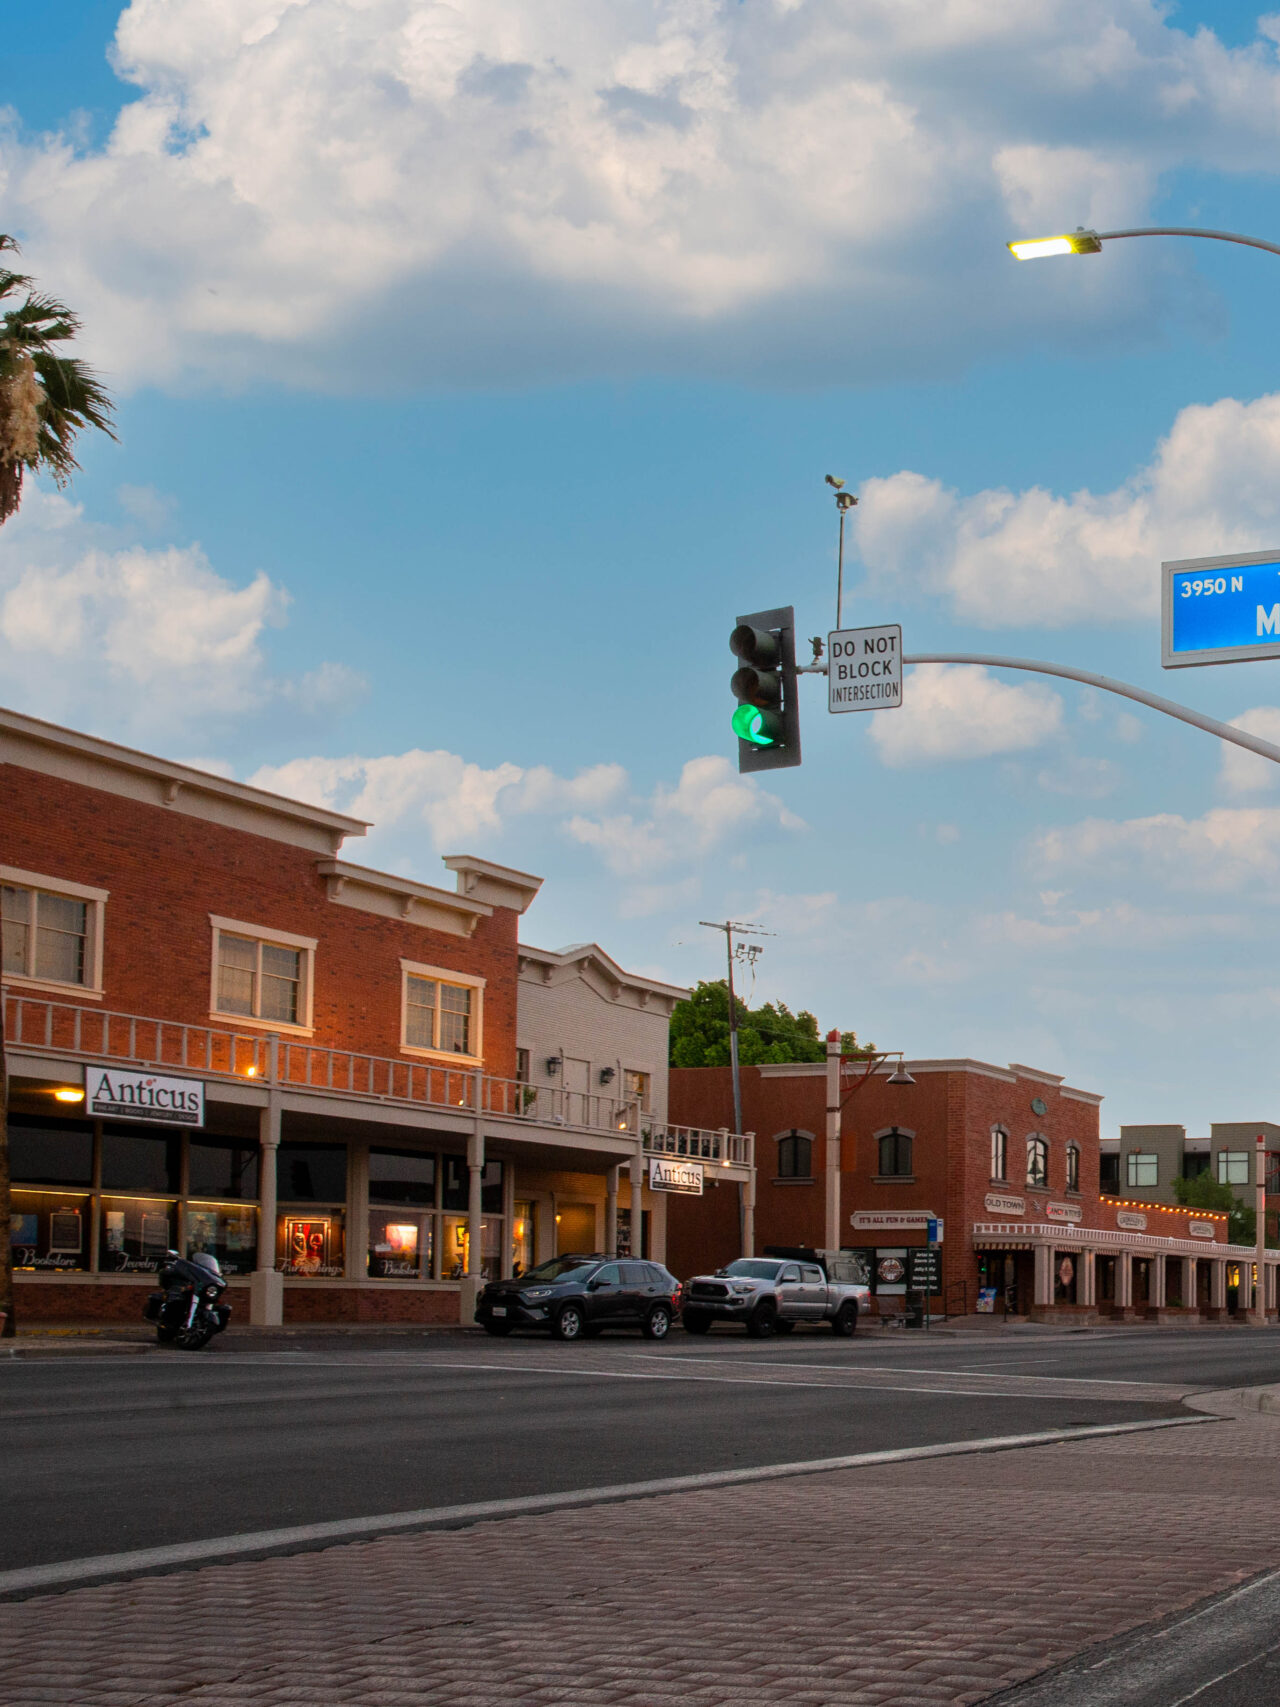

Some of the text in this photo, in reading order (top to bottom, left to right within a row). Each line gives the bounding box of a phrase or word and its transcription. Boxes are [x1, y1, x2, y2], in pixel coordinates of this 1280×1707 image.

[1181, 576, 1243, 598] 3950 N
[833, 636, 896, 658] DO NOT
[838, 660, 892, 680] BLOCK
[832, 682, 899, 703] INTERSECTION
[91, 1073, 199, 1111] Anticus
[652, 1162, 701, 1185] Anticus
[985, 1198, 1024, 1210] OLD TOWN
[859, 1216, 871, 1224] IT'S
[873, 1216, 884, 1224] ALL
[886, 1216, 898, 1224] FUN
[17, 1247, 76, 1267] Bookstore
[115, 1251, 158, 1272] Jewelry
[275, 1258, 345, 1276] Furnishings
